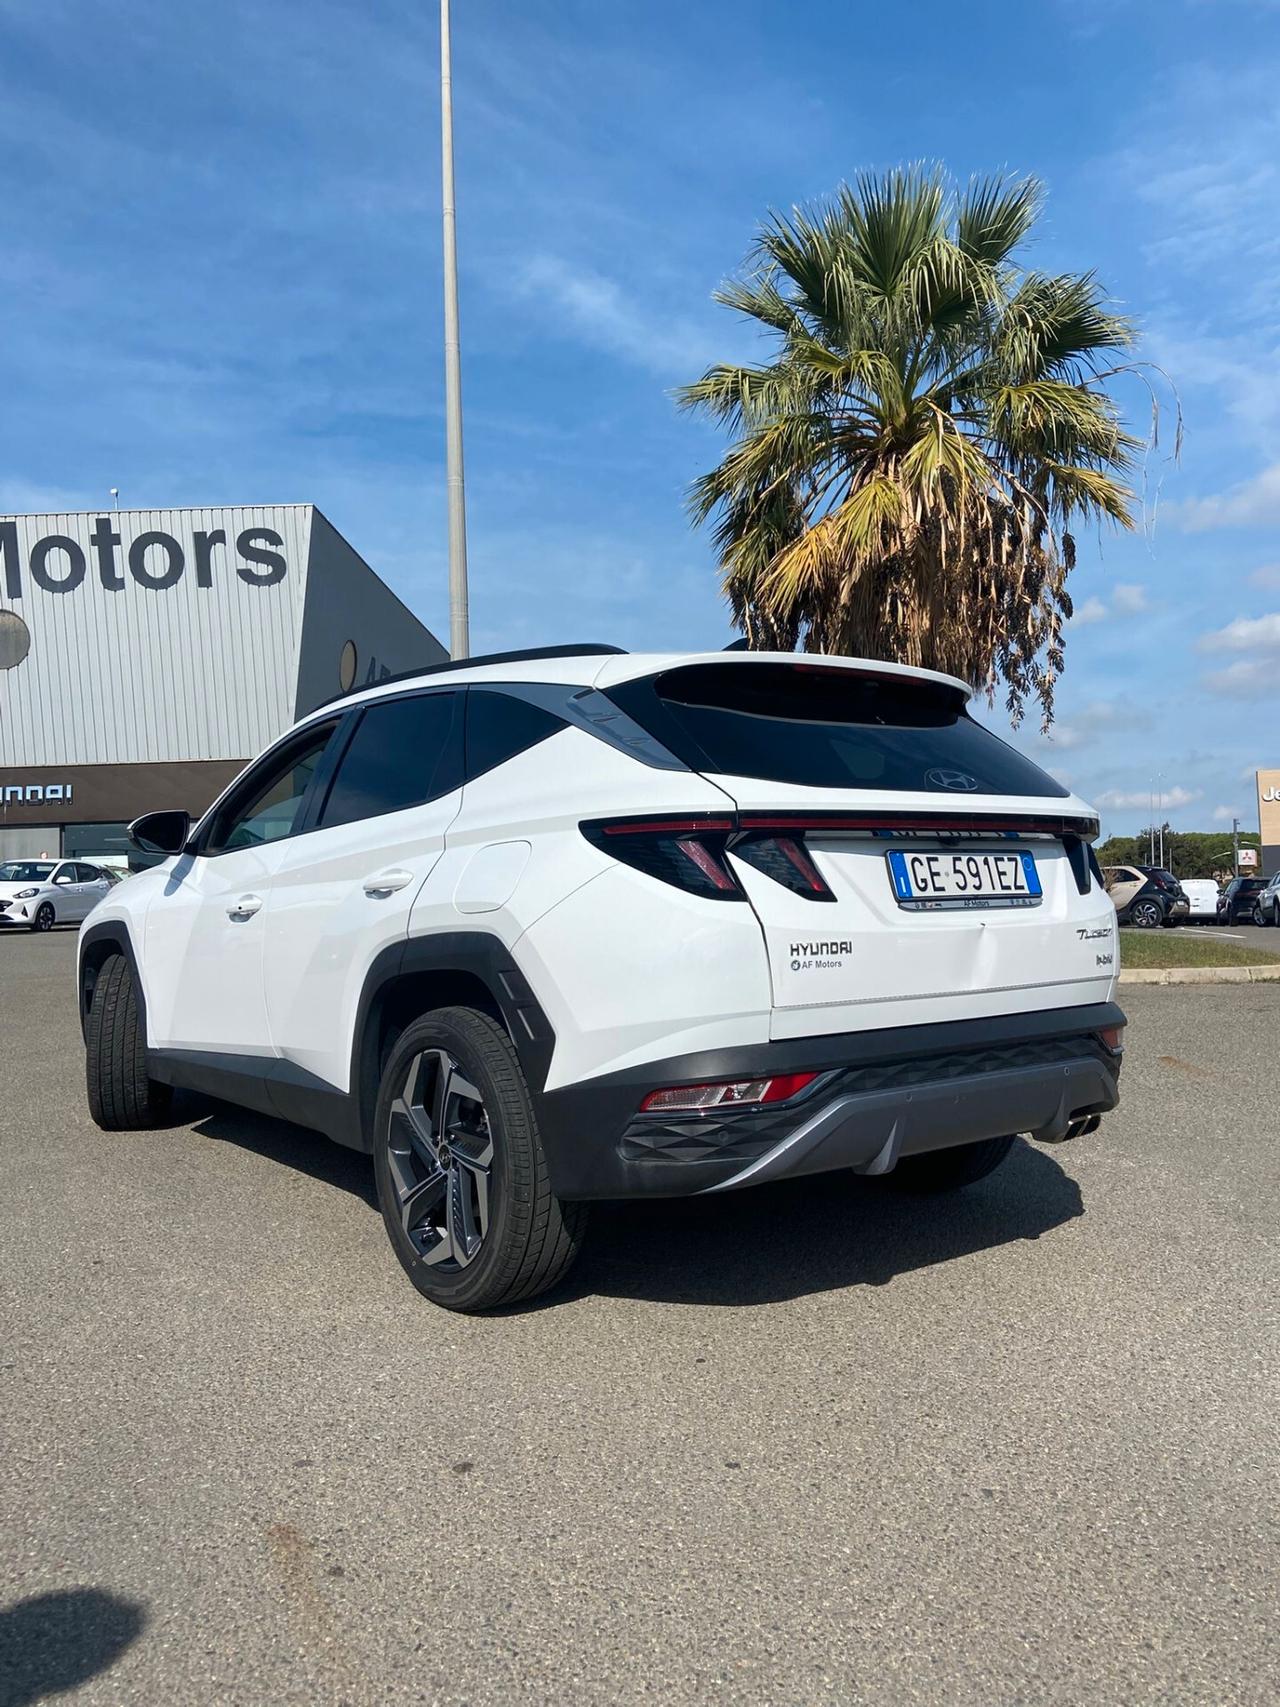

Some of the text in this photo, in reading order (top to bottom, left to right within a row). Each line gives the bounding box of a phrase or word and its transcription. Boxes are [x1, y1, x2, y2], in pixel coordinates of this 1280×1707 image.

[0, 785, 72, 804] NDAI
[910, 856, 1025, 892] GE 591EZ
[790, 941, 852, 956] HYUNDAI
[802, 960, 842, 969] AF Motors
